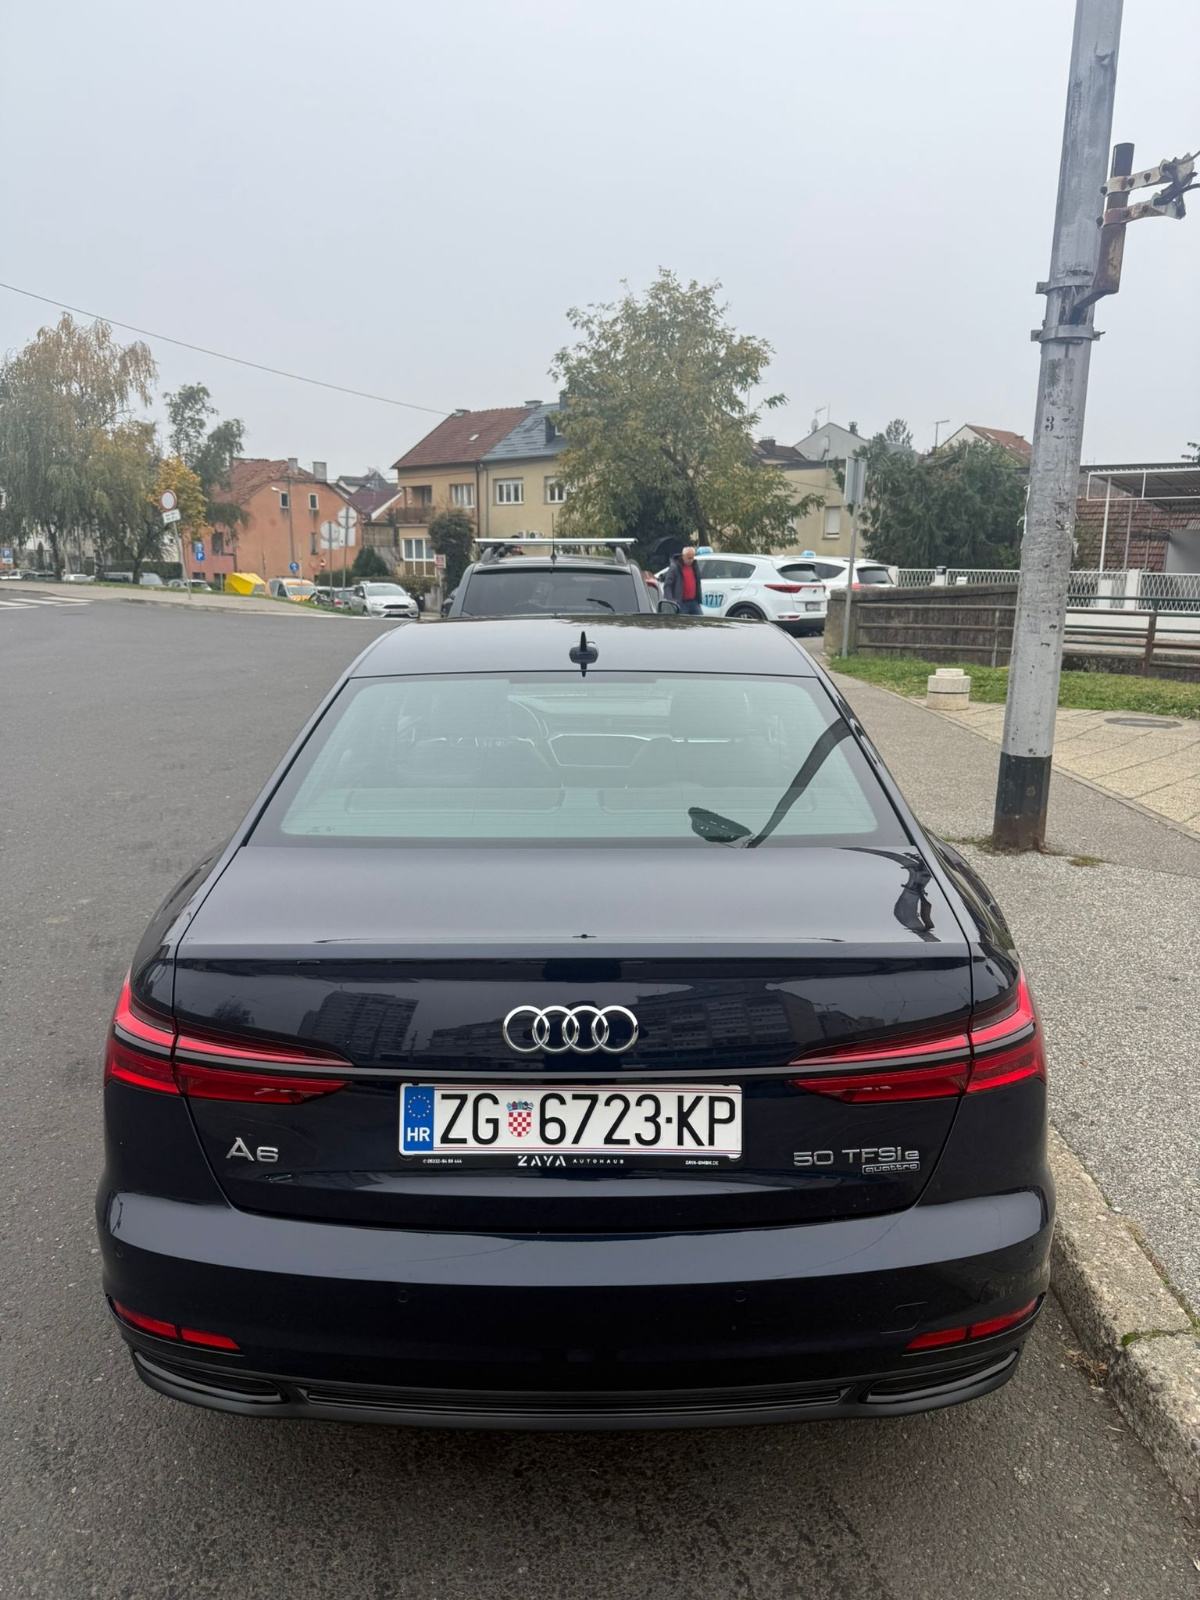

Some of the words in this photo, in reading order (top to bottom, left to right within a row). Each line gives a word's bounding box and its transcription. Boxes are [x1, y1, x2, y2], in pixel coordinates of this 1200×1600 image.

[705, 594, 724, 606] 1717
[440, 1092, 500, 1145] ZG
[407, 1127, 431, 1142] HR
[225, 1137, 279, 1162] A6
[517, 1155, 567, 1167] ZAYA
[793, 1150, 834, 1167] 50
[864, 1163, 919, 1173] quattro
